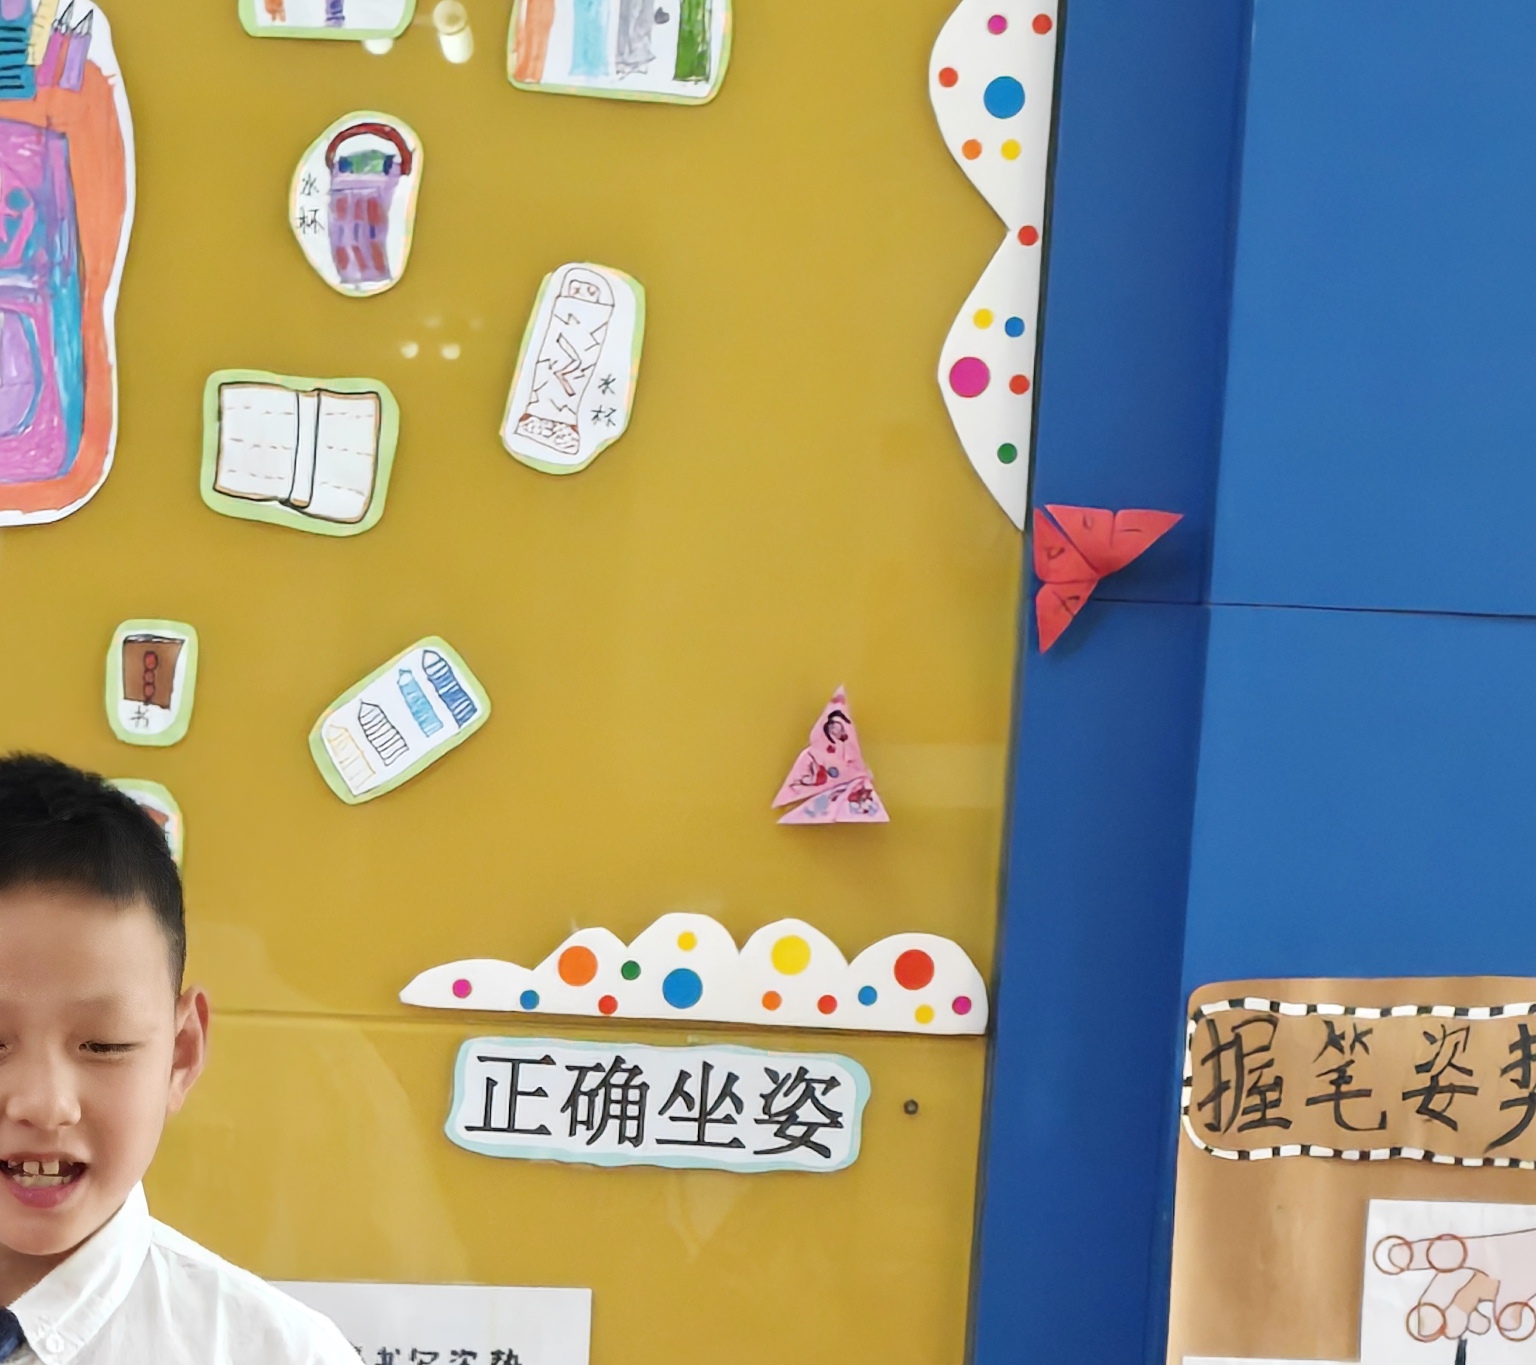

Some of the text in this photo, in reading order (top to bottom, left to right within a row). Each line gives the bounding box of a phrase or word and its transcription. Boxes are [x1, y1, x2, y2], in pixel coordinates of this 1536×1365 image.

[295, 172, 325, 235] 水杯
[590, 373, 617, 429] 水杯
[464, 1054, 845, 1160] 正确坐姿
